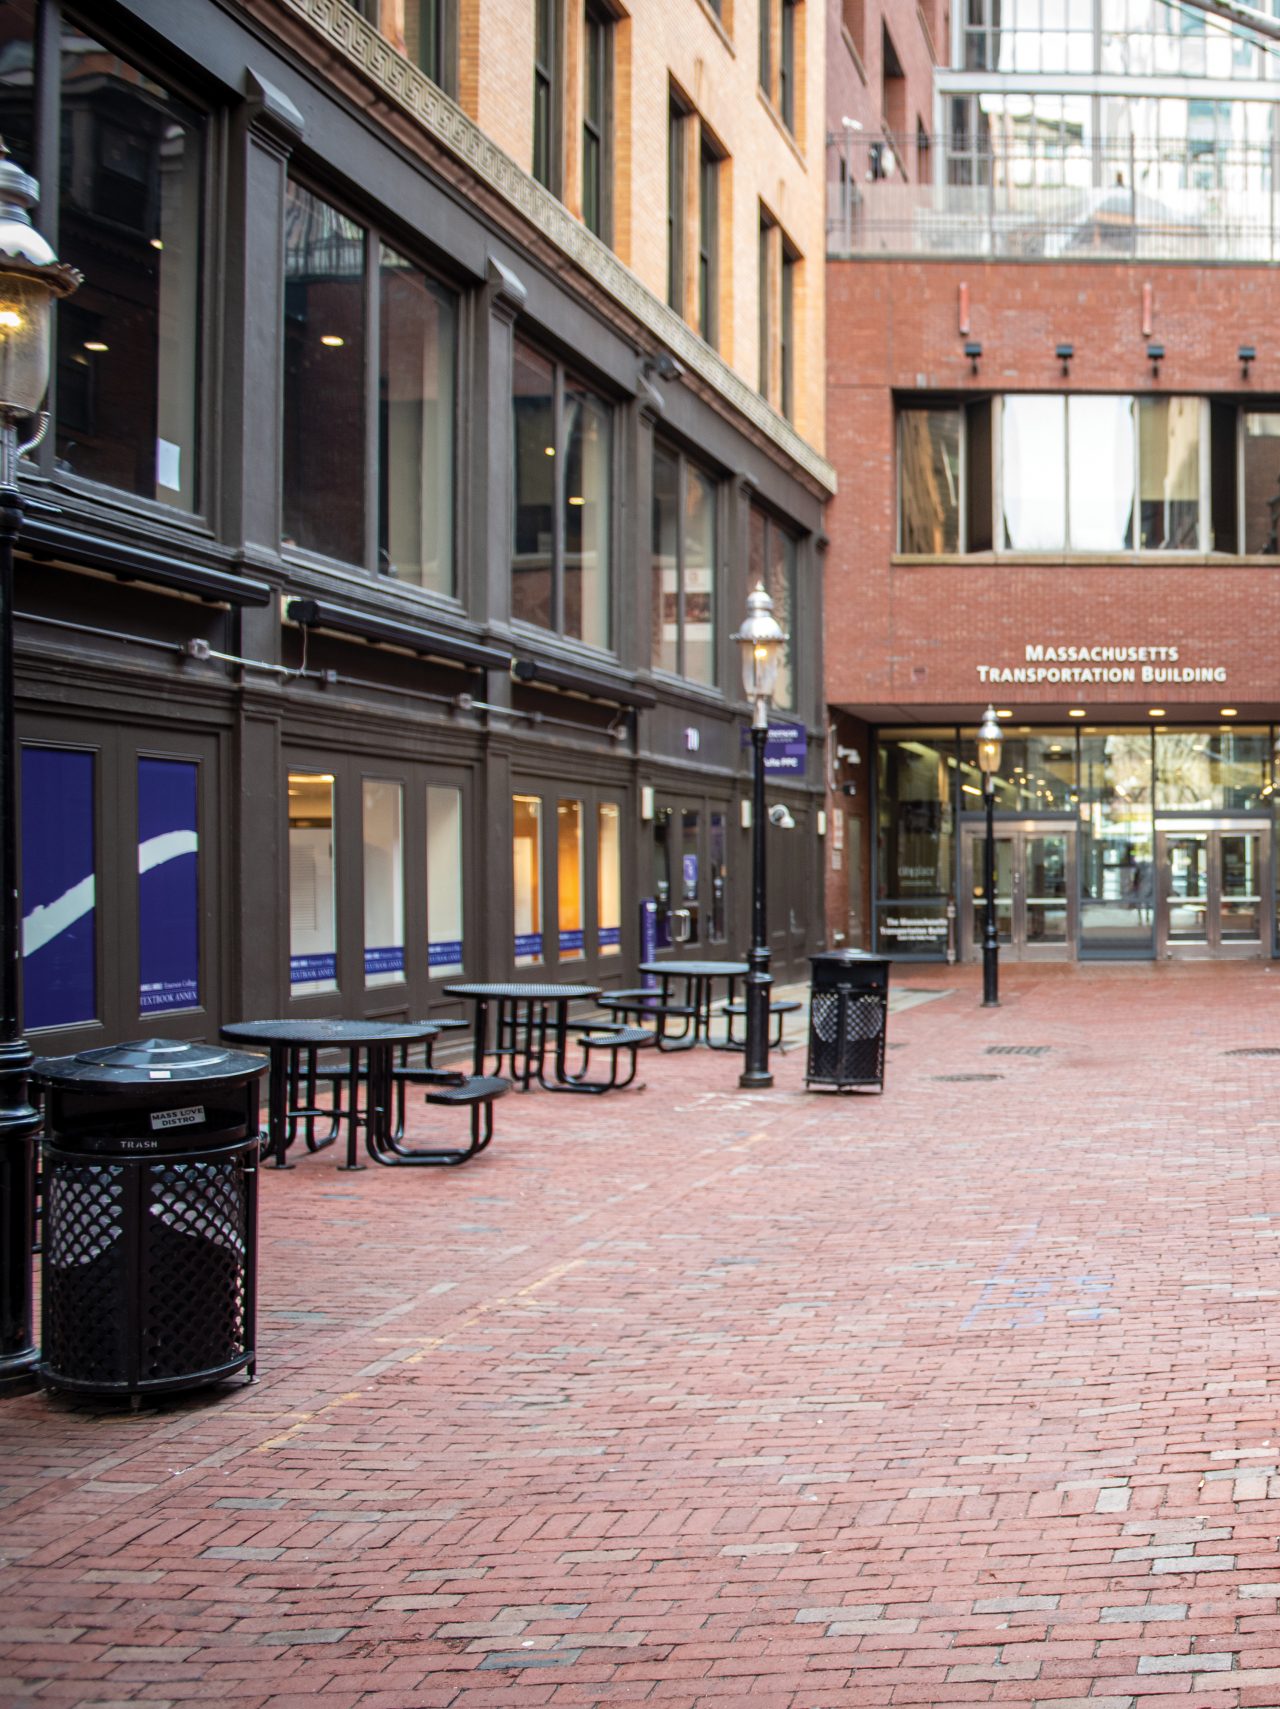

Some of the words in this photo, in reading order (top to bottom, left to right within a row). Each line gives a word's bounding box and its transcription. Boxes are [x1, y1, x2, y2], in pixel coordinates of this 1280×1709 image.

[1025, 644, 1179, 661] MASSACHUSETTS
[976, 665, 1135, 682] TRANSPORTATION
[1141, 666, 1226, 682] BUILDING
[140, 994, 174, 1006] TEXTBOOK
[175, 991, 198, 1001] ANNEX
[152, 1111, 178, 1121] MASS
[162, 1115, 195, 1127] DISTRO
[120, 1141, 158, 1149] TRASH
